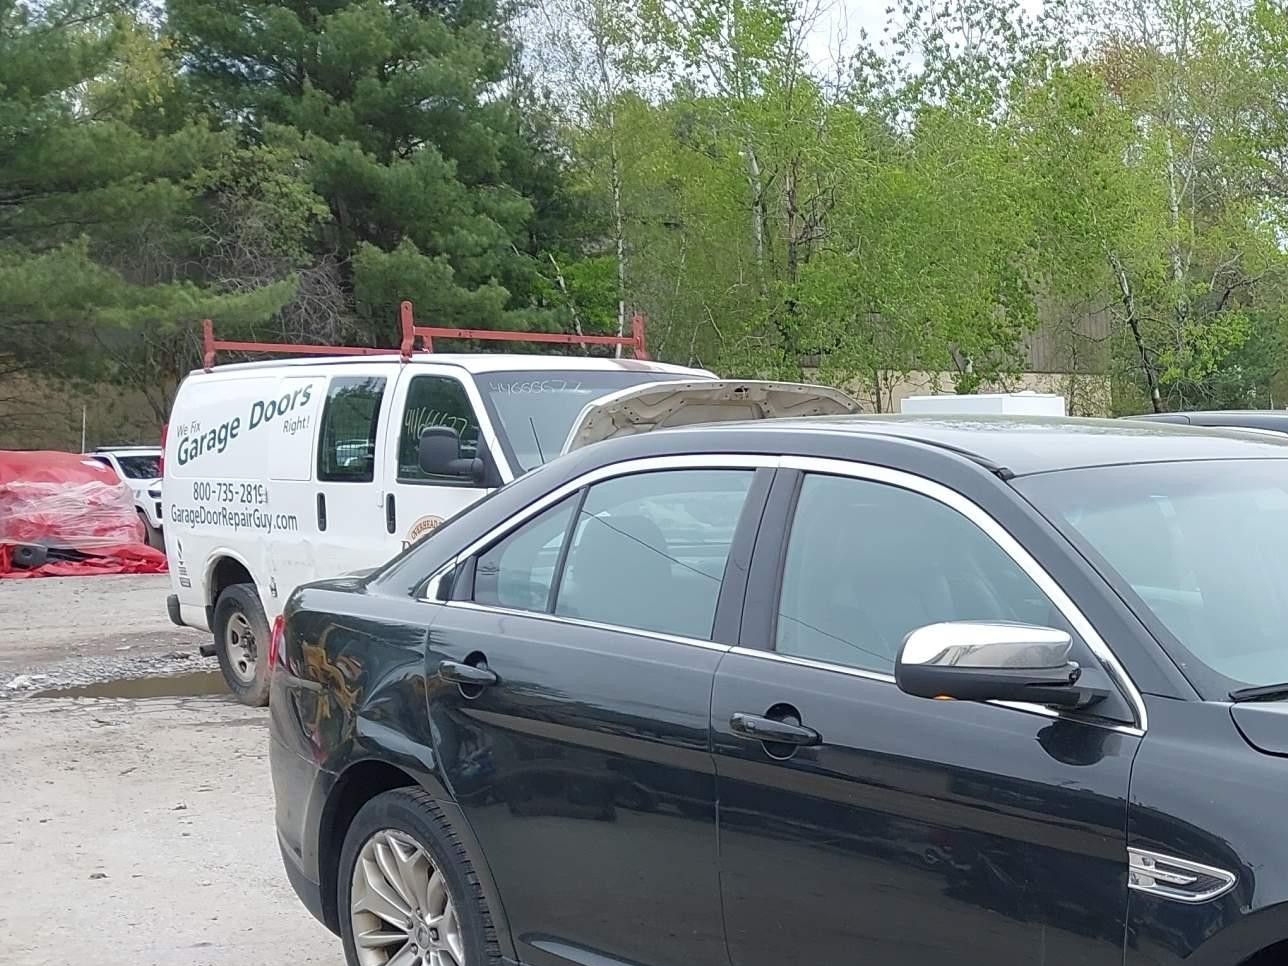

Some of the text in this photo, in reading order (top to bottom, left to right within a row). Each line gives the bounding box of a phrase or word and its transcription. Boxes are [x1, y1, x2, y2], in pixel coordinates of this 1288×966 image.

[177, 384, 313, 466] Garage Doors
[177, 420, 201, 437] We Fix
[282, 416, 311, 436] Right!
[171, 504, 298, 534] GarageDoorRepairGuy.com
